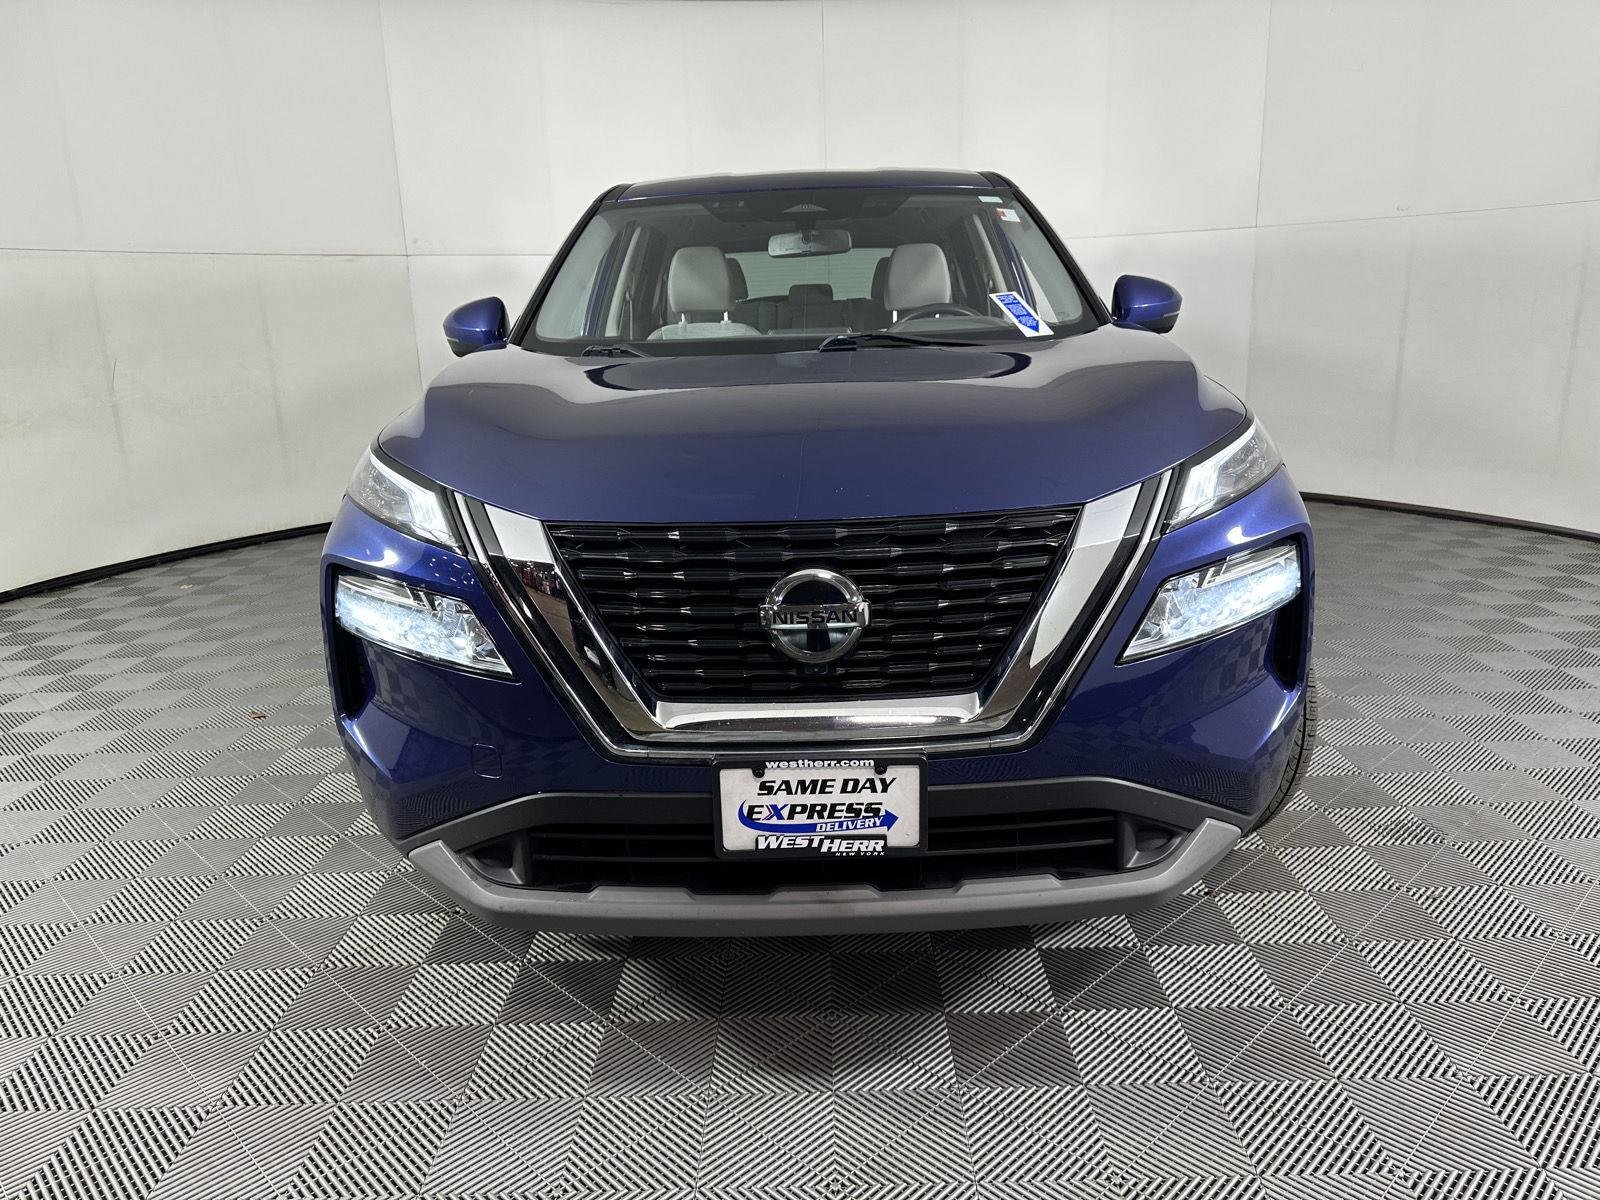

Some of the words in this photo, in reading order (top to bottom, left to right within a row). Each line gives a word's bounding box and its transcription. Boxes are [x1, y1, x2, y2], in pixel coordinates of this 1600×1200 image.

[773, 610, 857, 624] NISSAN
[765, 759, 875, 769] westherr.com
[757, 778, 836, 796] SAME
[839, 777, 897, 794] DAY
[746, 802, 883, 821] EXPRESS
[815, 817, 883, 832] DELIVERY
